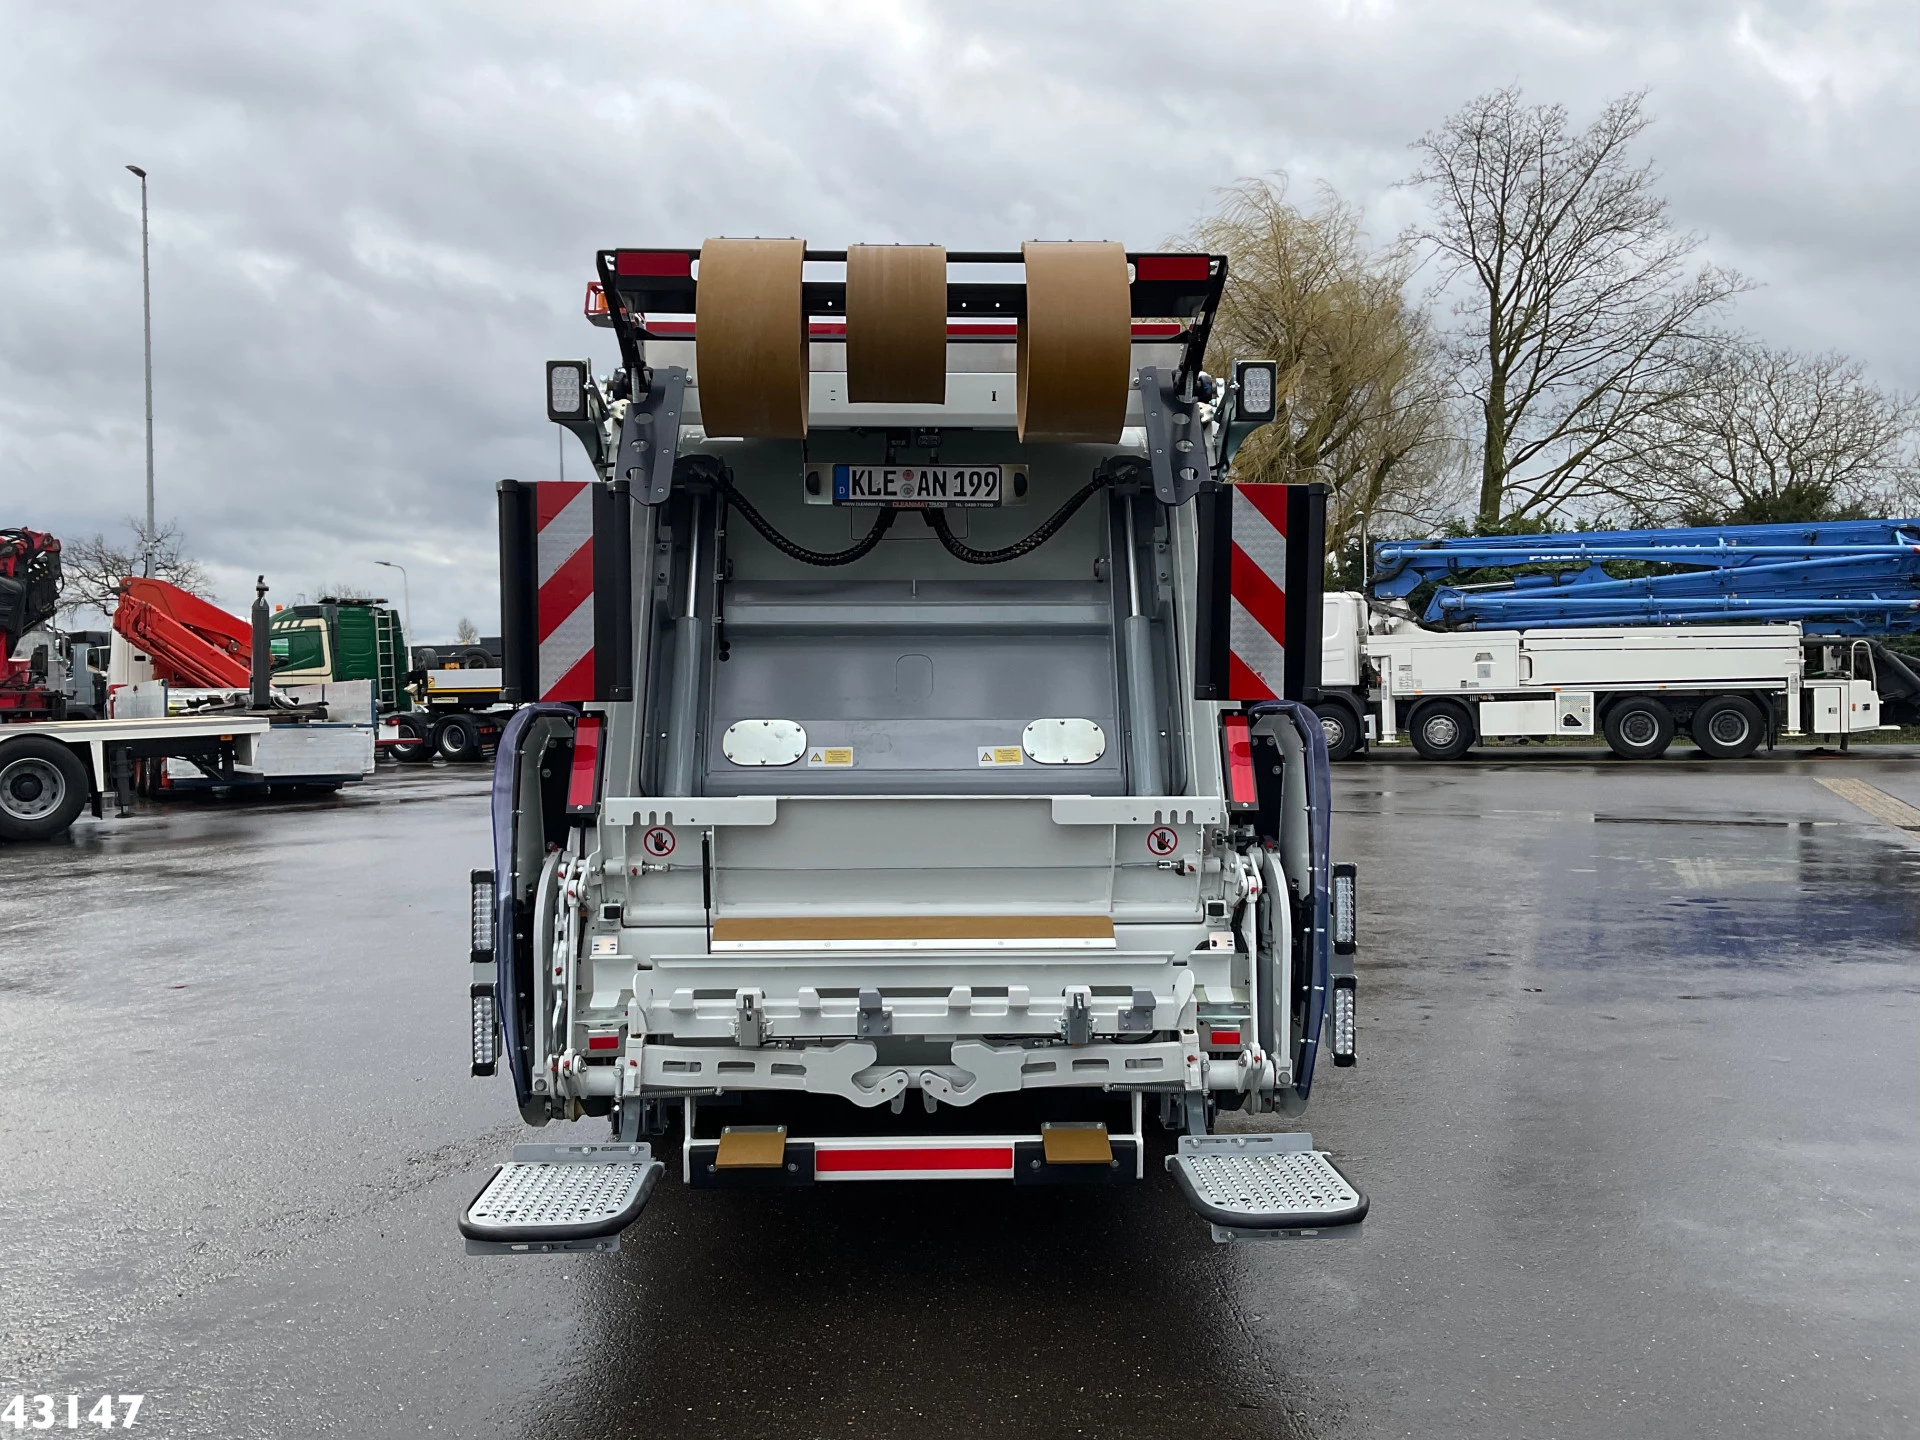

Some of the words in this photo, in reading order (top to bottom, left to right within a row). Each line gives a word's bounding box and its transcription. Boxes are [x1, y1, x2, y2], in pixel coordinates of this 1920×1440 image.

[839, 486, 846, 495] D
[851, 469, 898, 496] KLE
[916, 470, 947, 497] AN
[953, 471, 998, 497] 199
